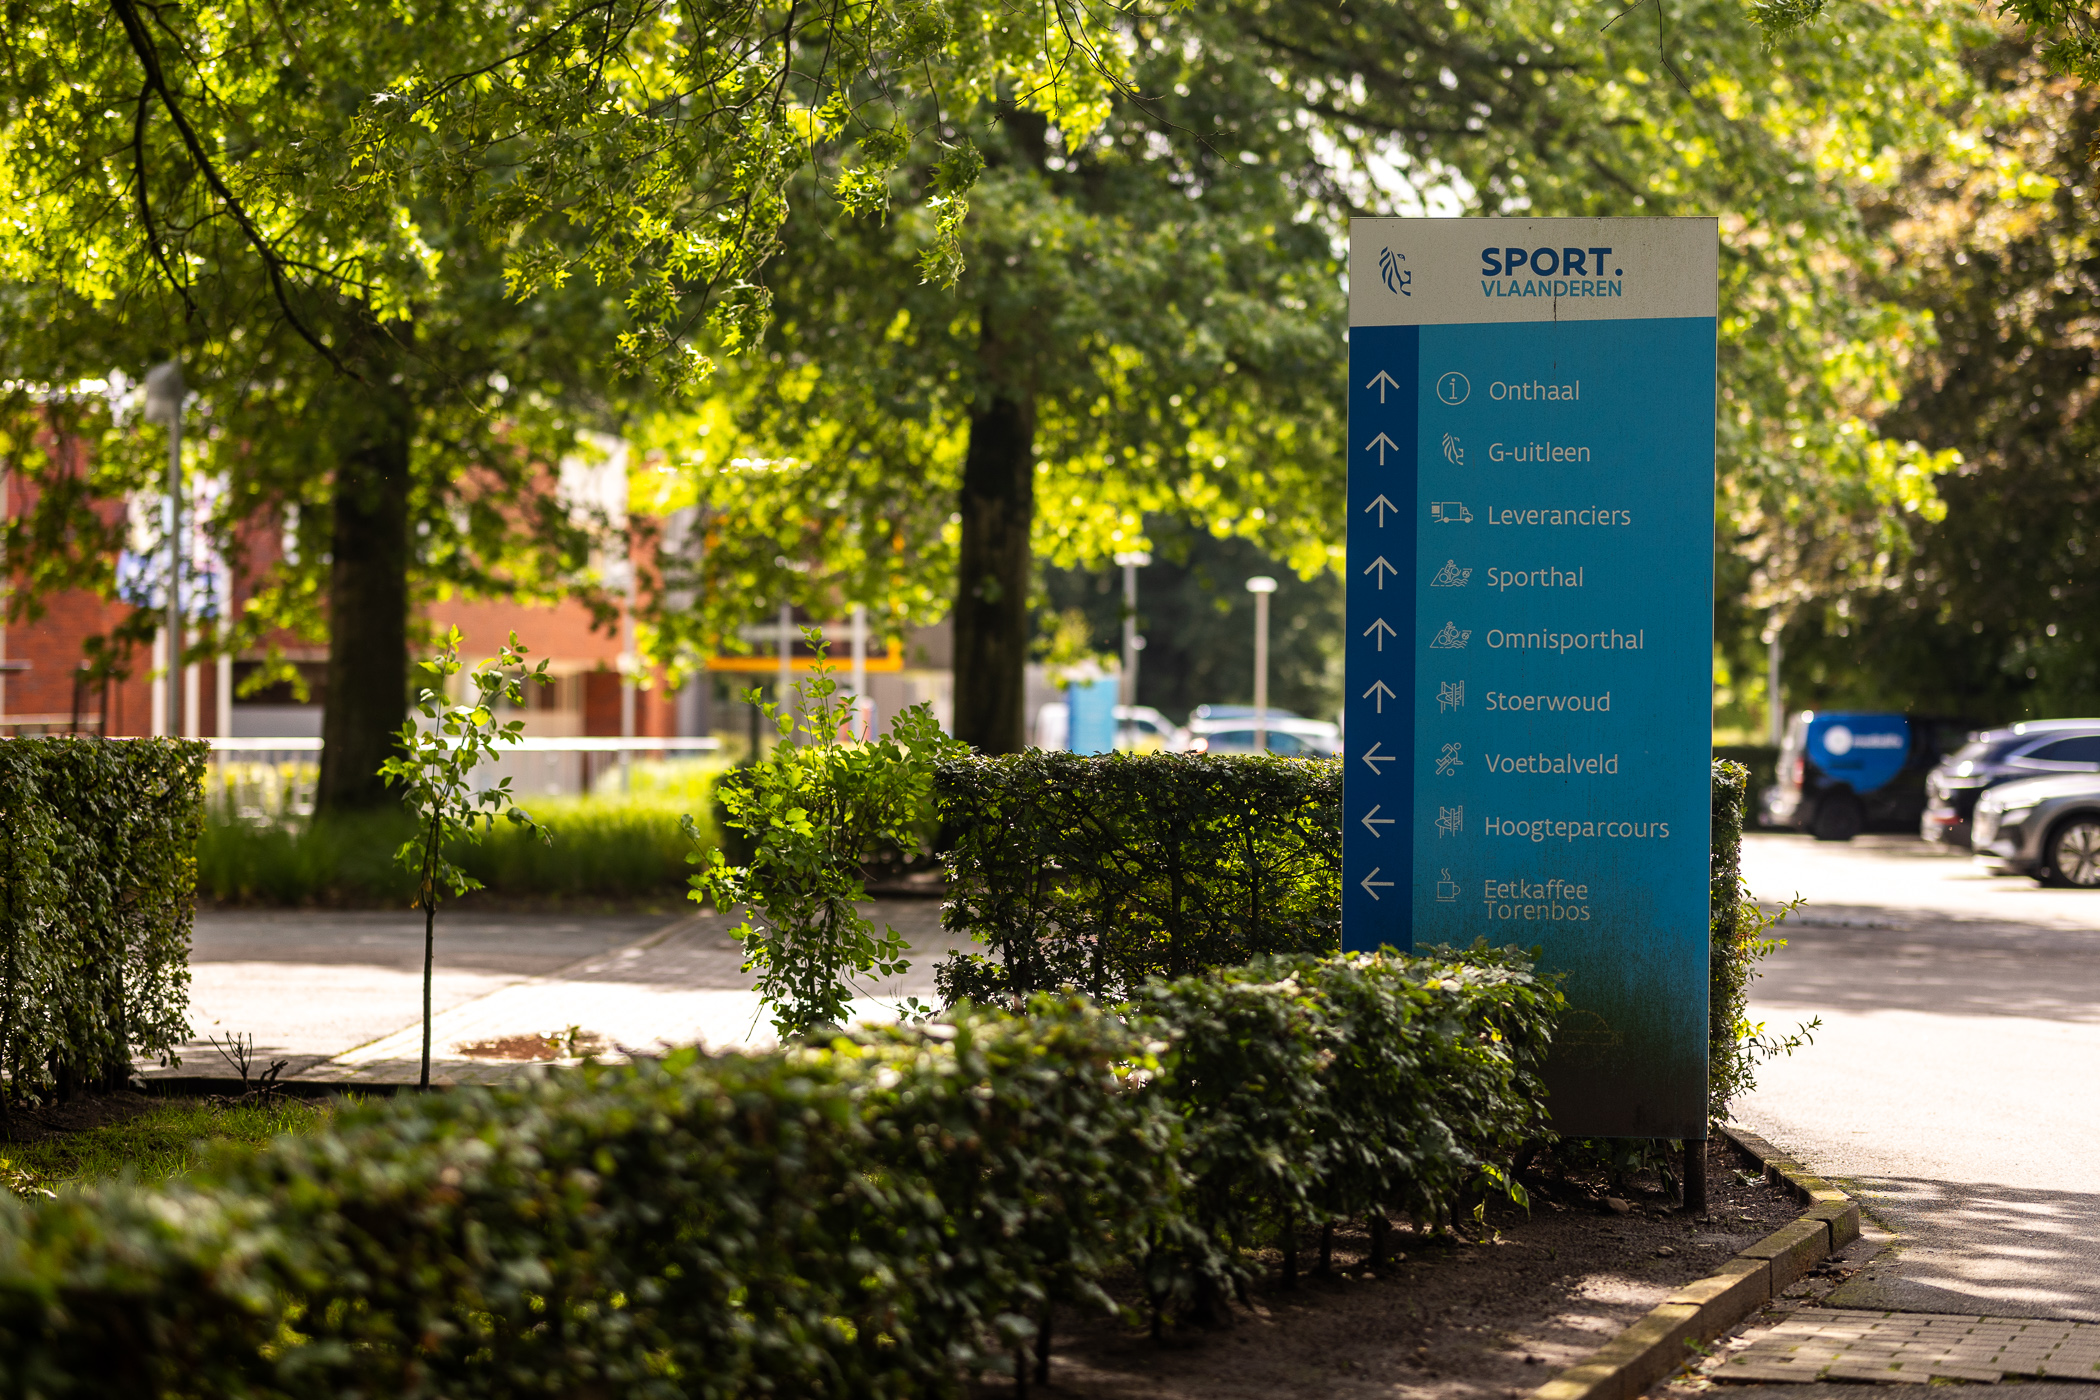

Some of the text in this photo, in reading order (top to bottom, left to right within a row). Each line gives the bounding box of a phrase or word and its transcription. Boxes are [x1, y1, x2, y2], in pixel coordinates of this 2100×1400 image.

[1481, 247, 1624, 277] SPORT.
[1481, 279, 1622, 297] VLAANDEREN
[1489, 379, 1580, 401] Onthaal
[1488, 441, 1591, 462] G-uitleen
[1488, 505, 1631, 526] Leveranciers
[1487, 566, 1583, 593] Sporthal
[1486, 628, 1644, 655] Omnisporthal
[1486, 691, 1610, 712] Stoerwoud
[1485, 752, 1618, 774] Voetbalveld
[1485, 816, 1670, 843] Hoogteparcours
[1483, 878, 1588, 900] Eetkaffee
[1483, 900, 1591, 921] Torenbos
